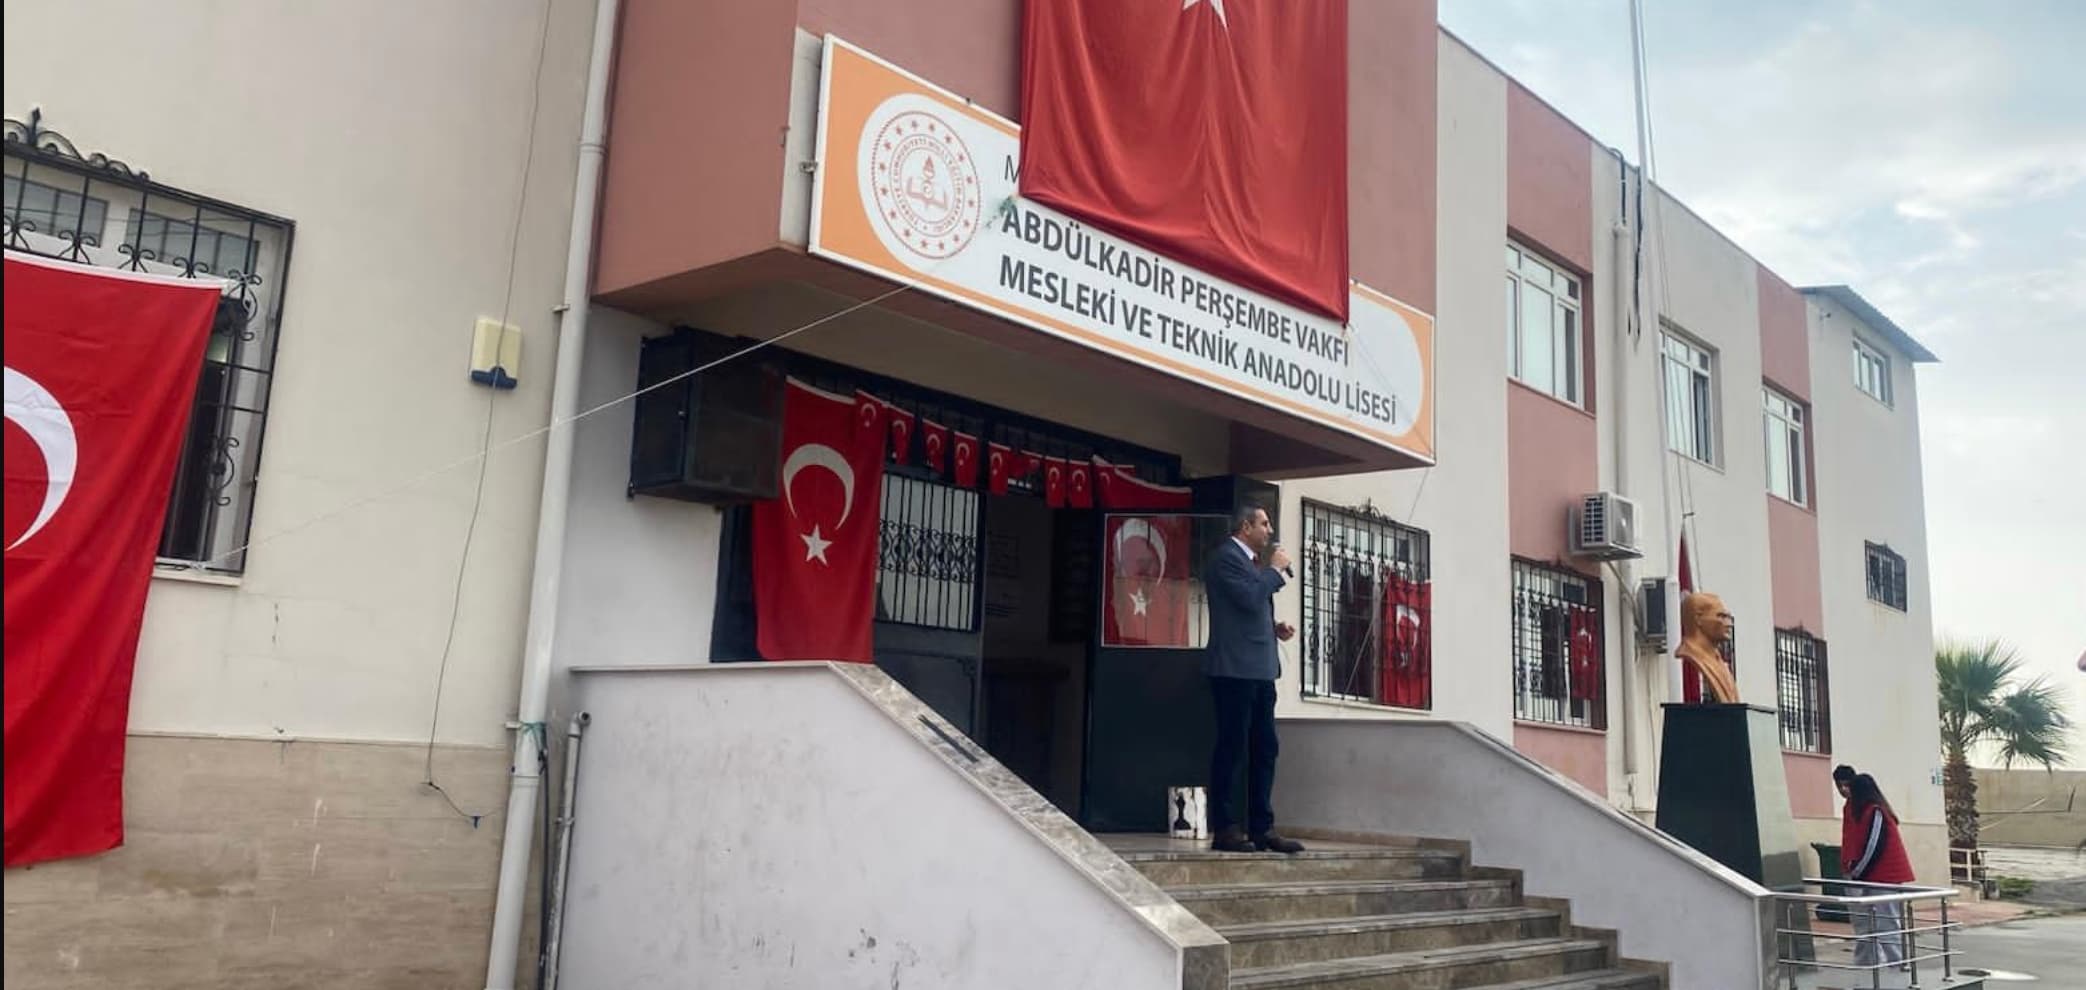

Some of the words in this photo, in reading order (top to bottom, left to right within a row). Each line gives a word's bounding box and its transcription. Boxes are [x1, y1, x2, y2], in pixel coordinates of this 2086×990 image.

[1000, 254, 1116, 326] MESLEKİ
[1122, 299, 1153, 340] VE
[1157, 313, 1239, 370] TEKNİK
[1243, 347, 1340, 405] ANADOLU
[1345, 381, 1396, 425] LİSESİ
[1002, 203, 1175, 299] ABDÜLKADİR
[1181, 275, 1291, 344] PERŞEMBE
[1295, 321, 1349, 366] VAKFI
